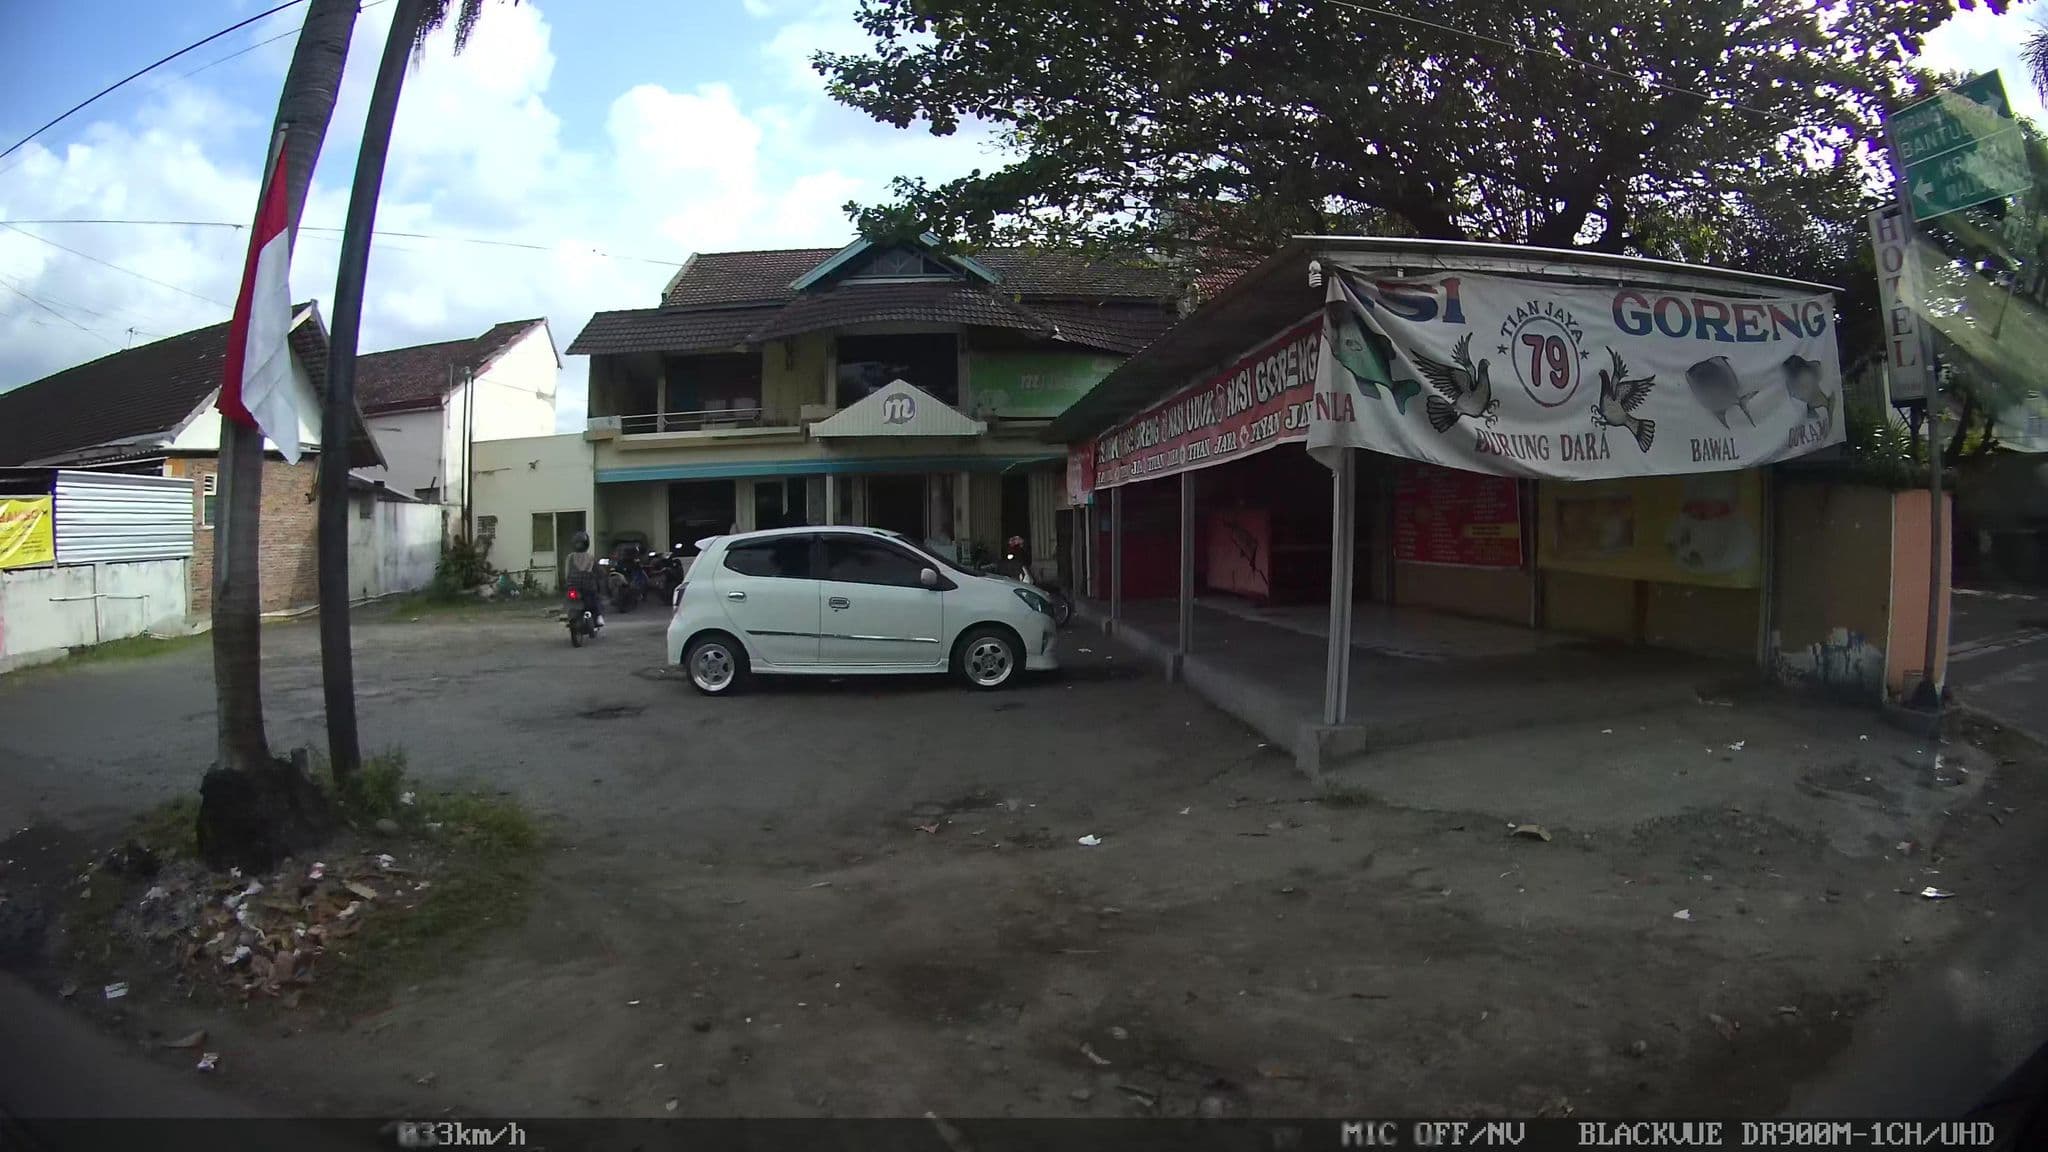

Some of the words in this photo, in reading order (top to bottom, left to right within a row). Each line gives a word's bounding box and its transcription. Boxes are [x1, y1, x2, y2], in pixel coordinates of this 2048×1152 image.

[1878, 213, 1919, 368] HOTEL
[1501, 300, 1540, 337] TIAN
[1544, 302, 1583, 344] JAYA
[1612, 289, 1827, 342] GORENG
[1227, 367, 1252, 417] NASI
[1255, 333, 1318, 403] GORENG
[1521, 333, 1570, 390] 79
[1474, 428, 1550, 461] BURUNG
[1559, 431, 1611, 462] DARA
[1690, 437, 1740, 462] BAWAL
